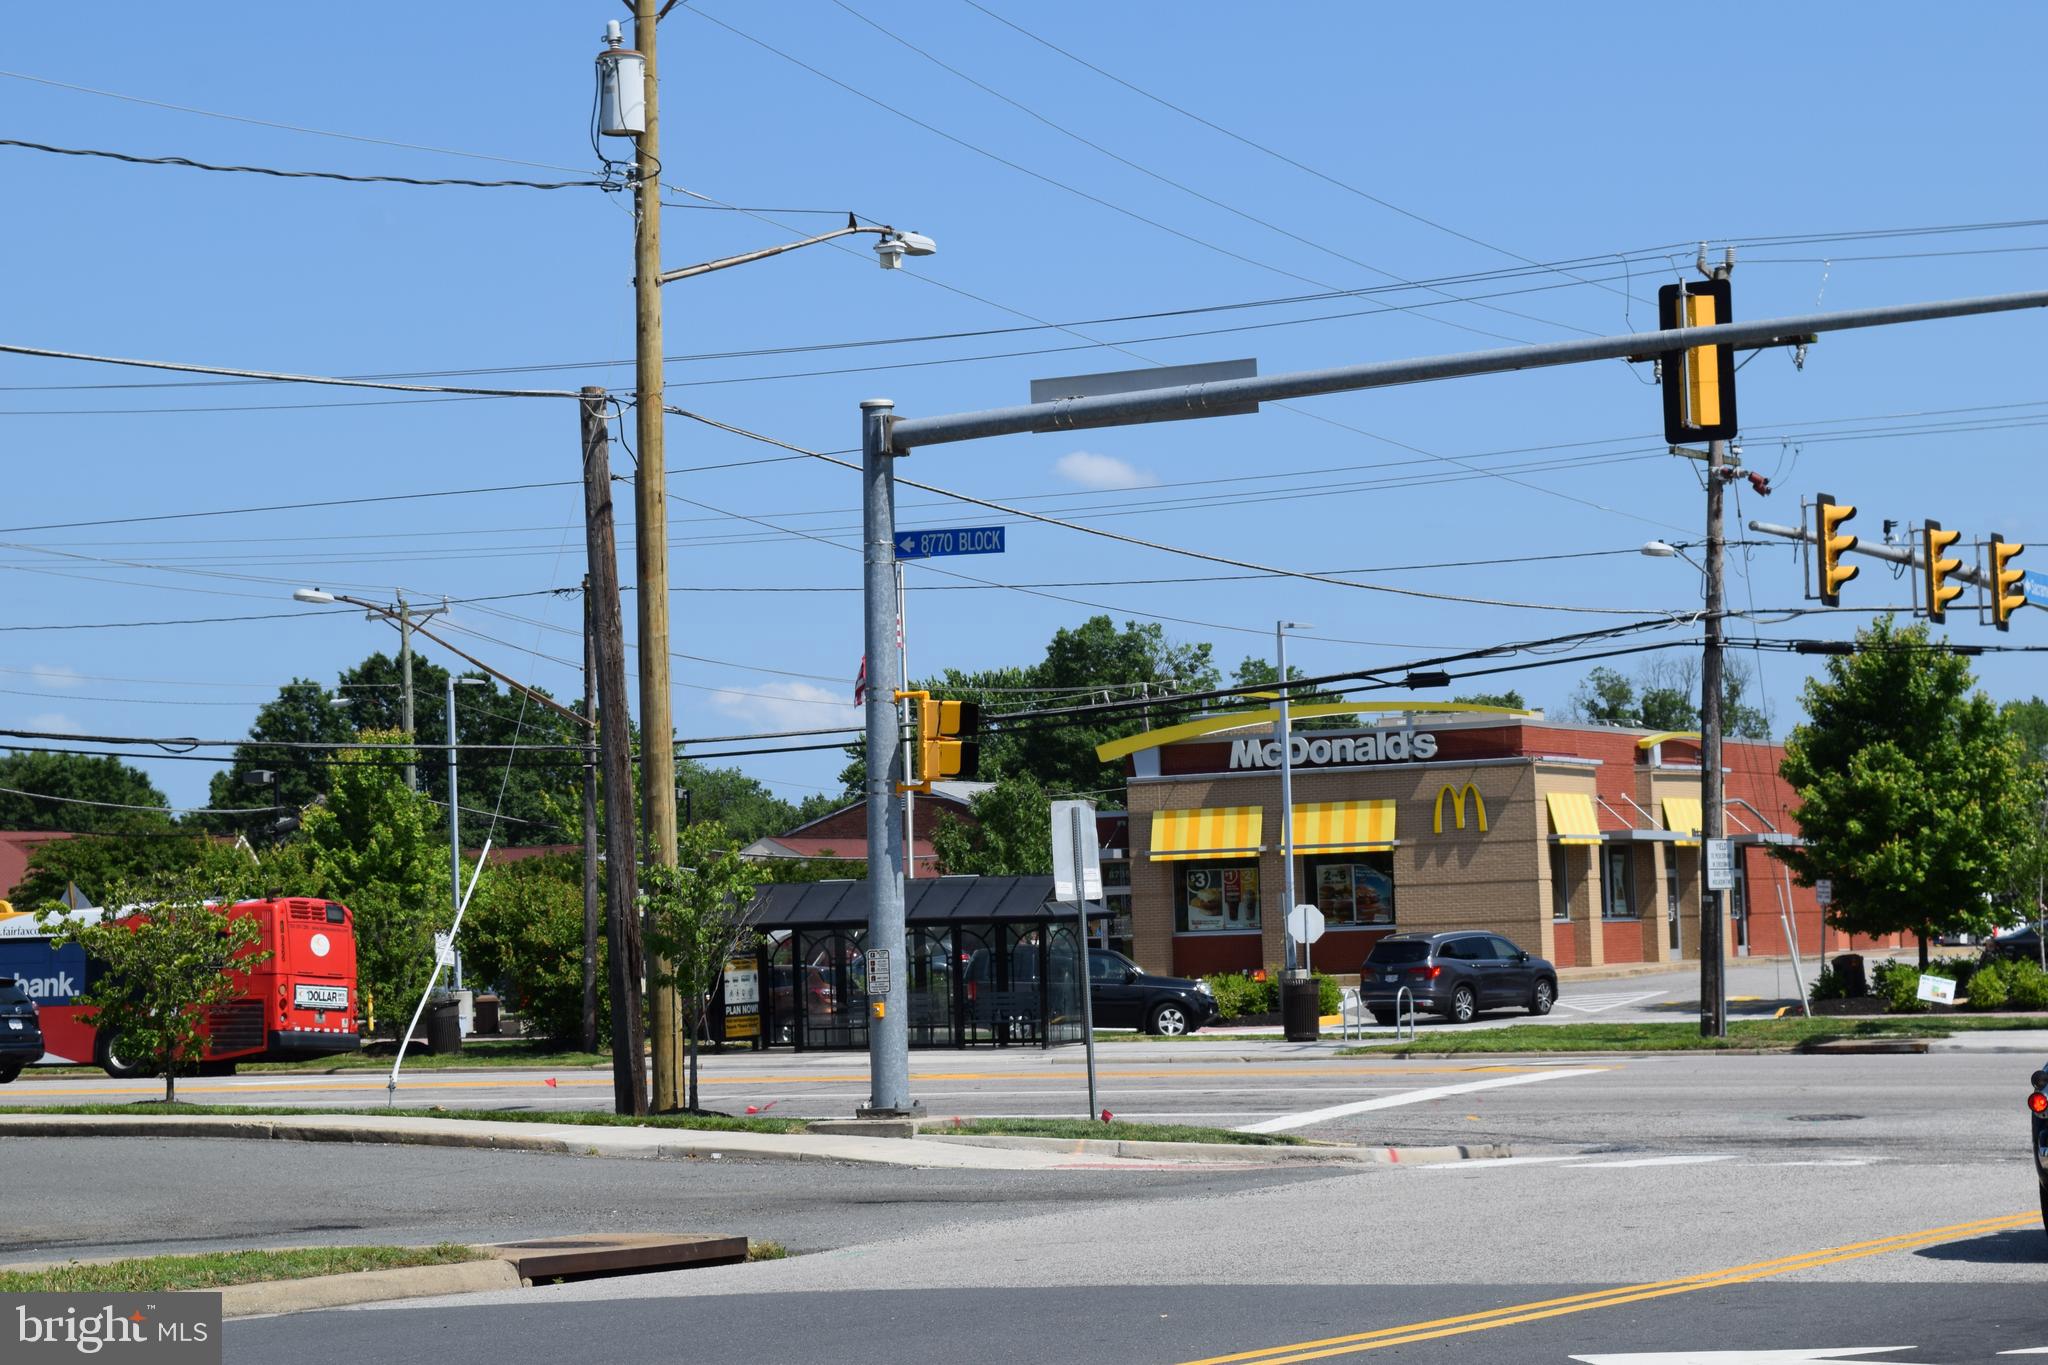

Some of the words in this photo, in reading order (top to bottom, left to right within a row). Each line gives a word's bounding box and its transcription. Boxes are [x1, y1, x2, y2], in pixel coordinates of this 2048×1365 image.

[920, 533, 953, 553] 8770
[958, 530, 1001, 551] BLOCK
[1229, 731, 1438, 769] McDonald's
[14, 971, 80, 998] bank.
[725, 1005, 741, 1016] PLAN
